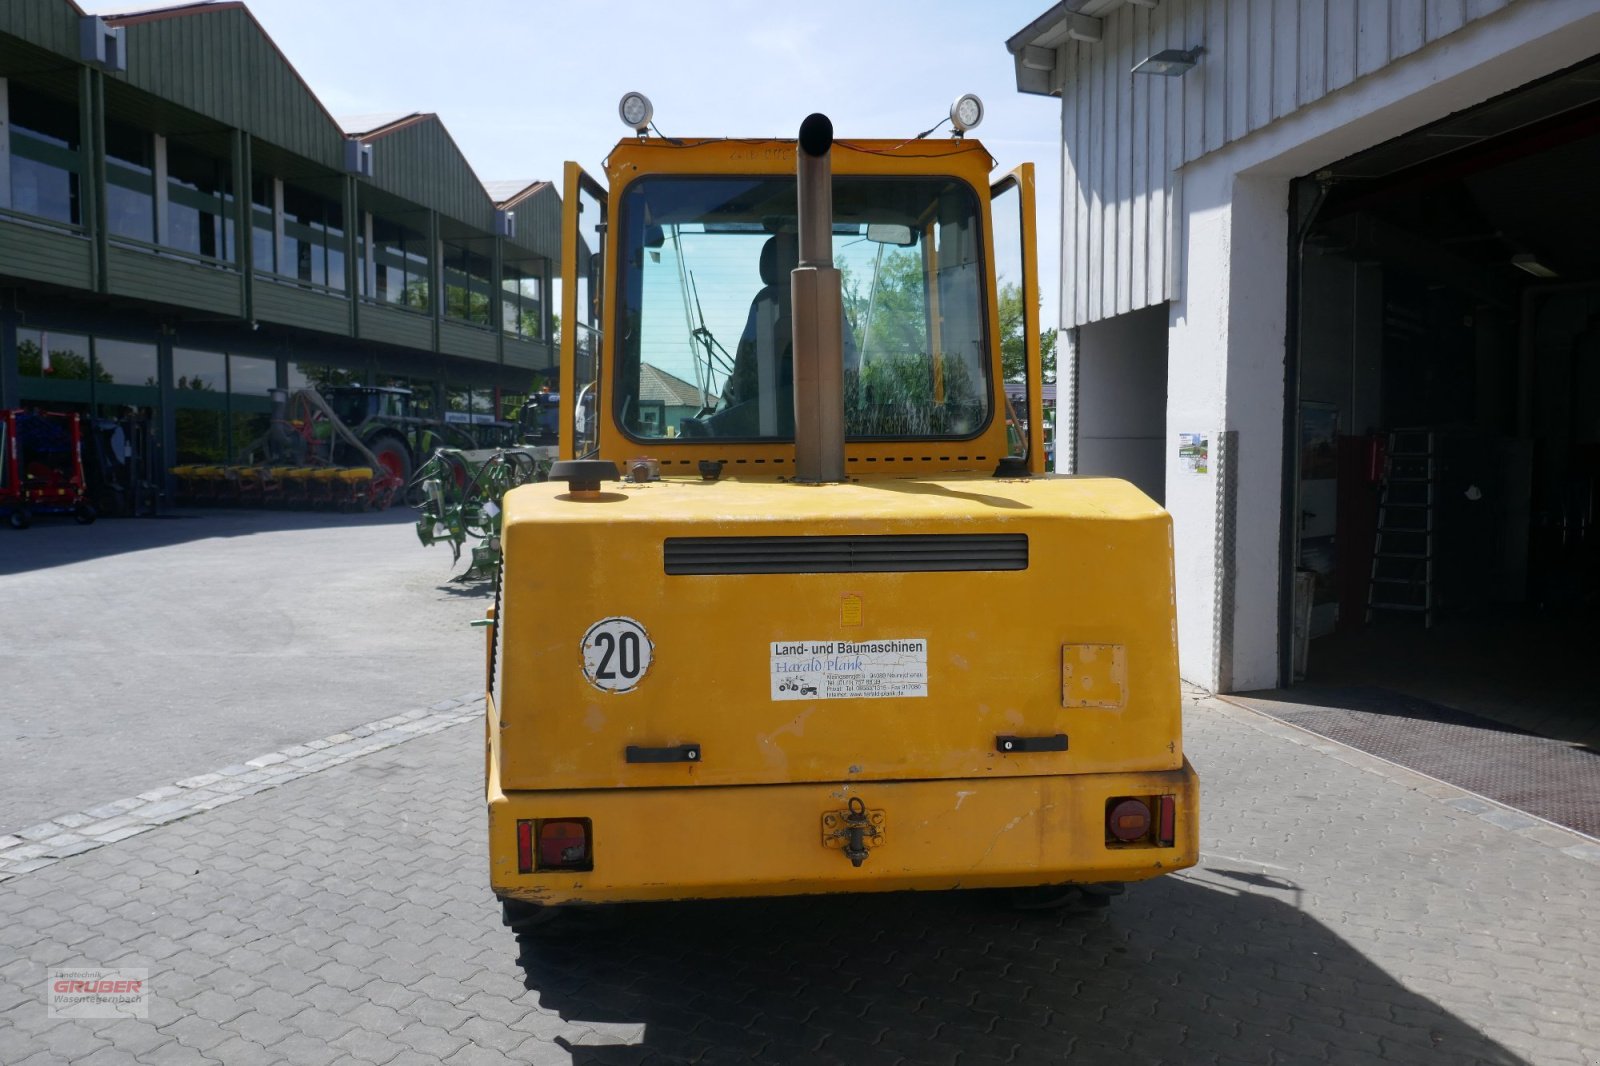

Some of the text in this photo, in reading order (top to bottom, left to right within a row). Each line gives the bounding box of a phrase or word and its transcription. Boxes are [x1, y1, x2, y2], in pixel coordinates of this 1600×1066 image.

[594, 631, 641, 680] 20
[775, 641, 923, 655] Land- und Baumaschinen
[776, 656, 863, 672] Harald Plank
